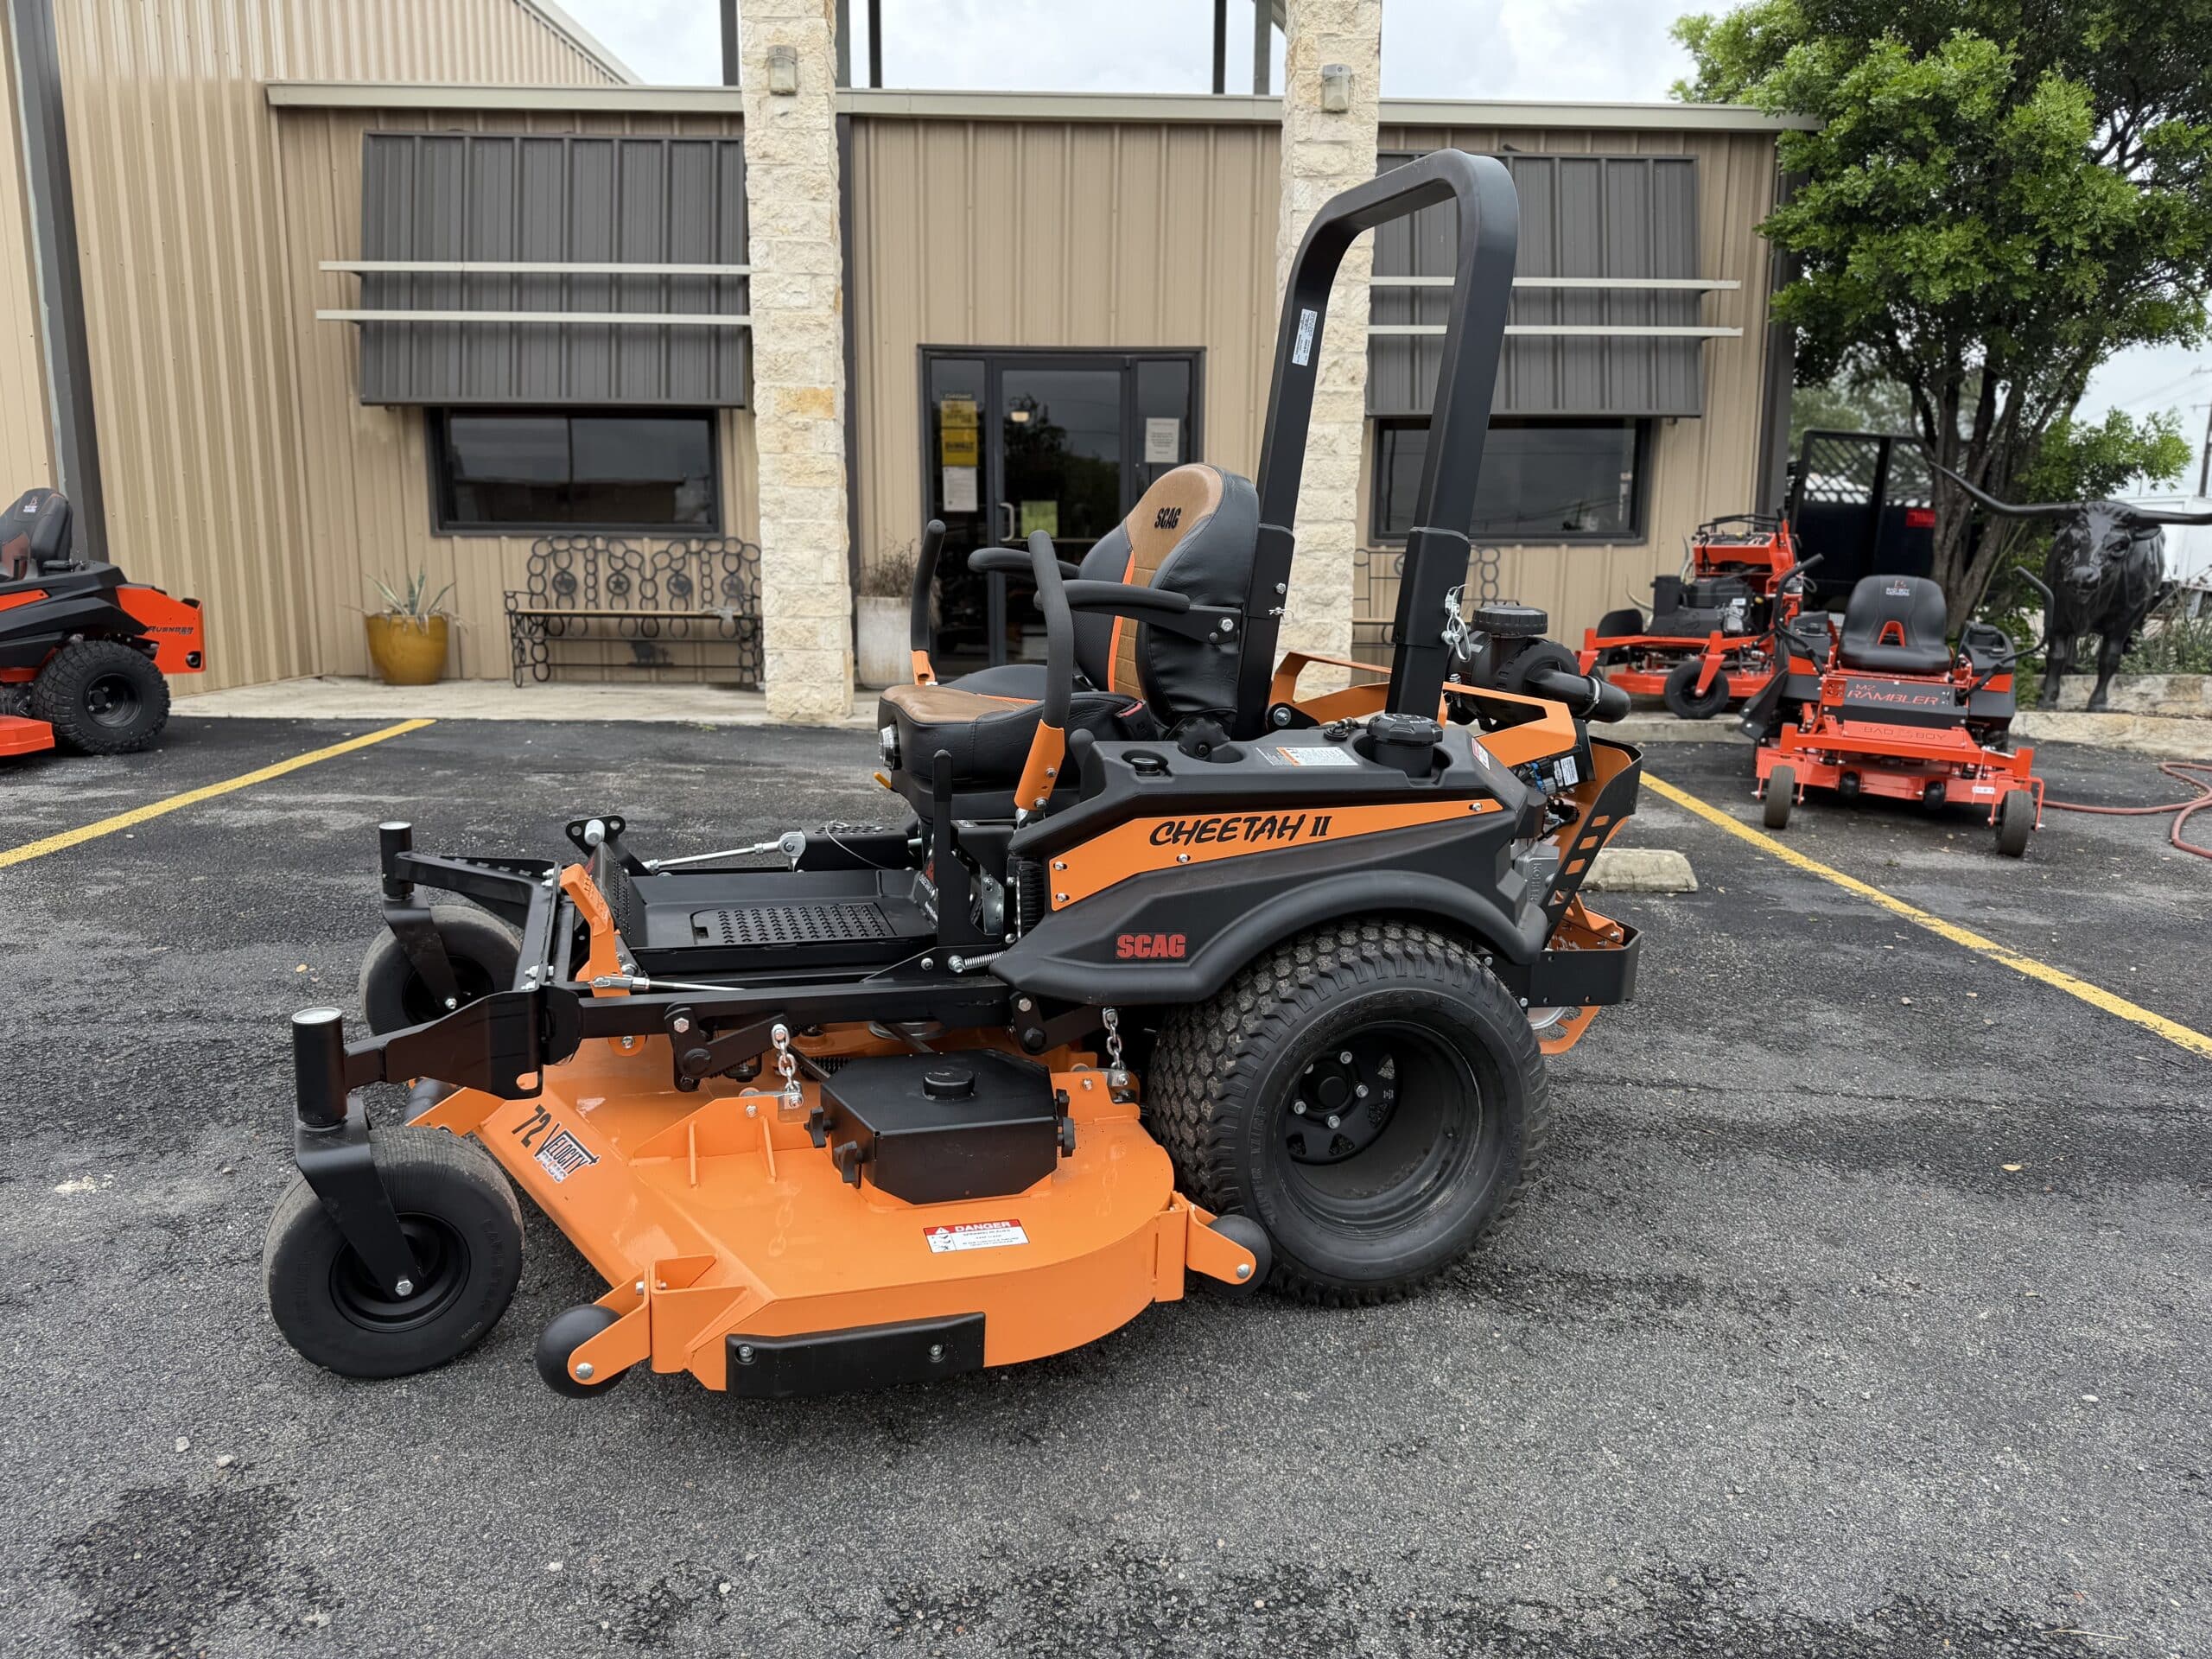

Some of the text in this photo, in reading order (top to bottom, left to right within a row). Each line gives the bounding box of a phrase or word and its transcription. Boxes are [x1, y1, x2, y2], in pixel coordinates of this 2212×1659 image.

[1154, 506, 1182, 530] SCAG
[1847, 690, 1939, 706] RAMBLER
[1864, 726, 1948, 741] BAD BOY
[1149, 814, 1332, 846] CHEETAH II
[1116, 934, 1186, 958] SCAG
[512, 1104, 551, 1148] 72
[534, 1122, 600, 1174] VELOCITY
[954, 1221, 1012, 1233] DANGER
